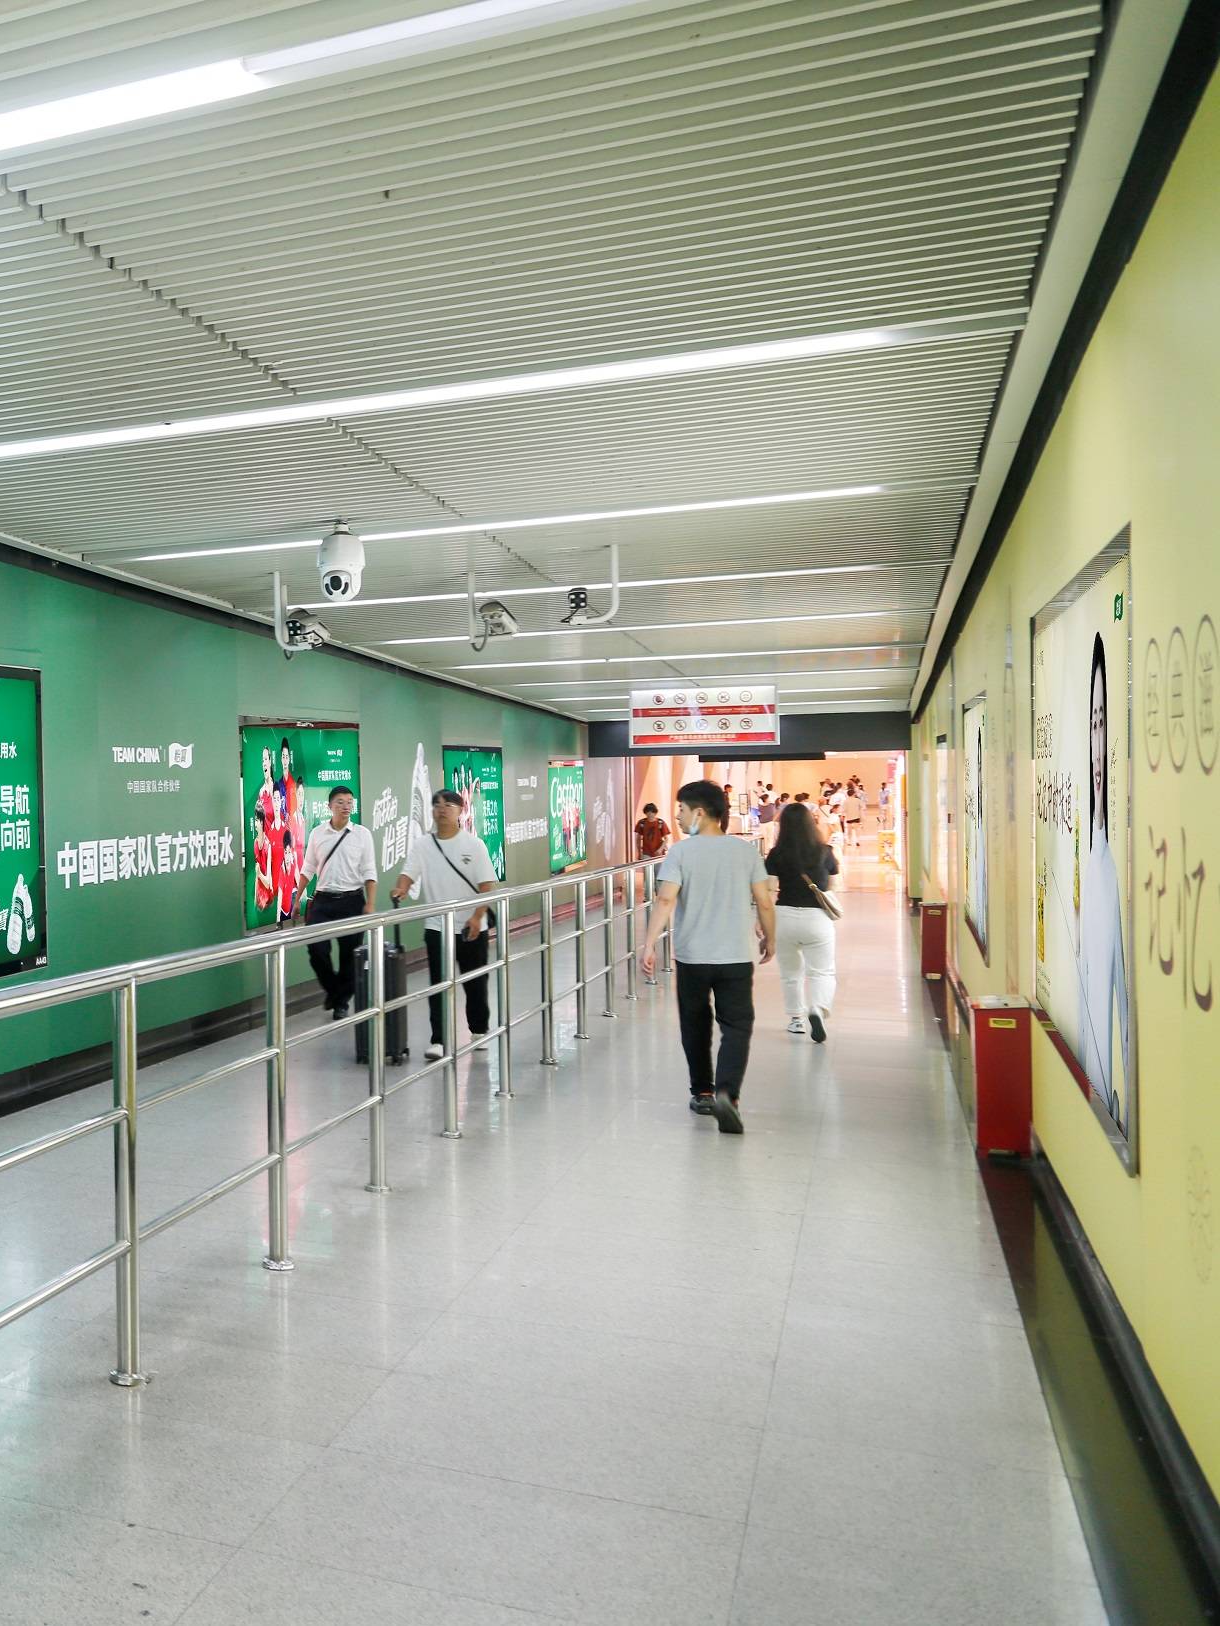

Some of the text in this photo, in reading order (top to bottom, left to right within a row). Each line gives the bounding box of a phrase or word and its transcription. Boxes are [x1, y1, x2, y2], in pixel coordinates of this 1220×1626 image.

[112, 747, 161, 763] TEAM CHINA
[127, 780, 181, 793] 中国国家队合作伙伴
[57, 827, 234, 889] 中国国家队官方饮用水
